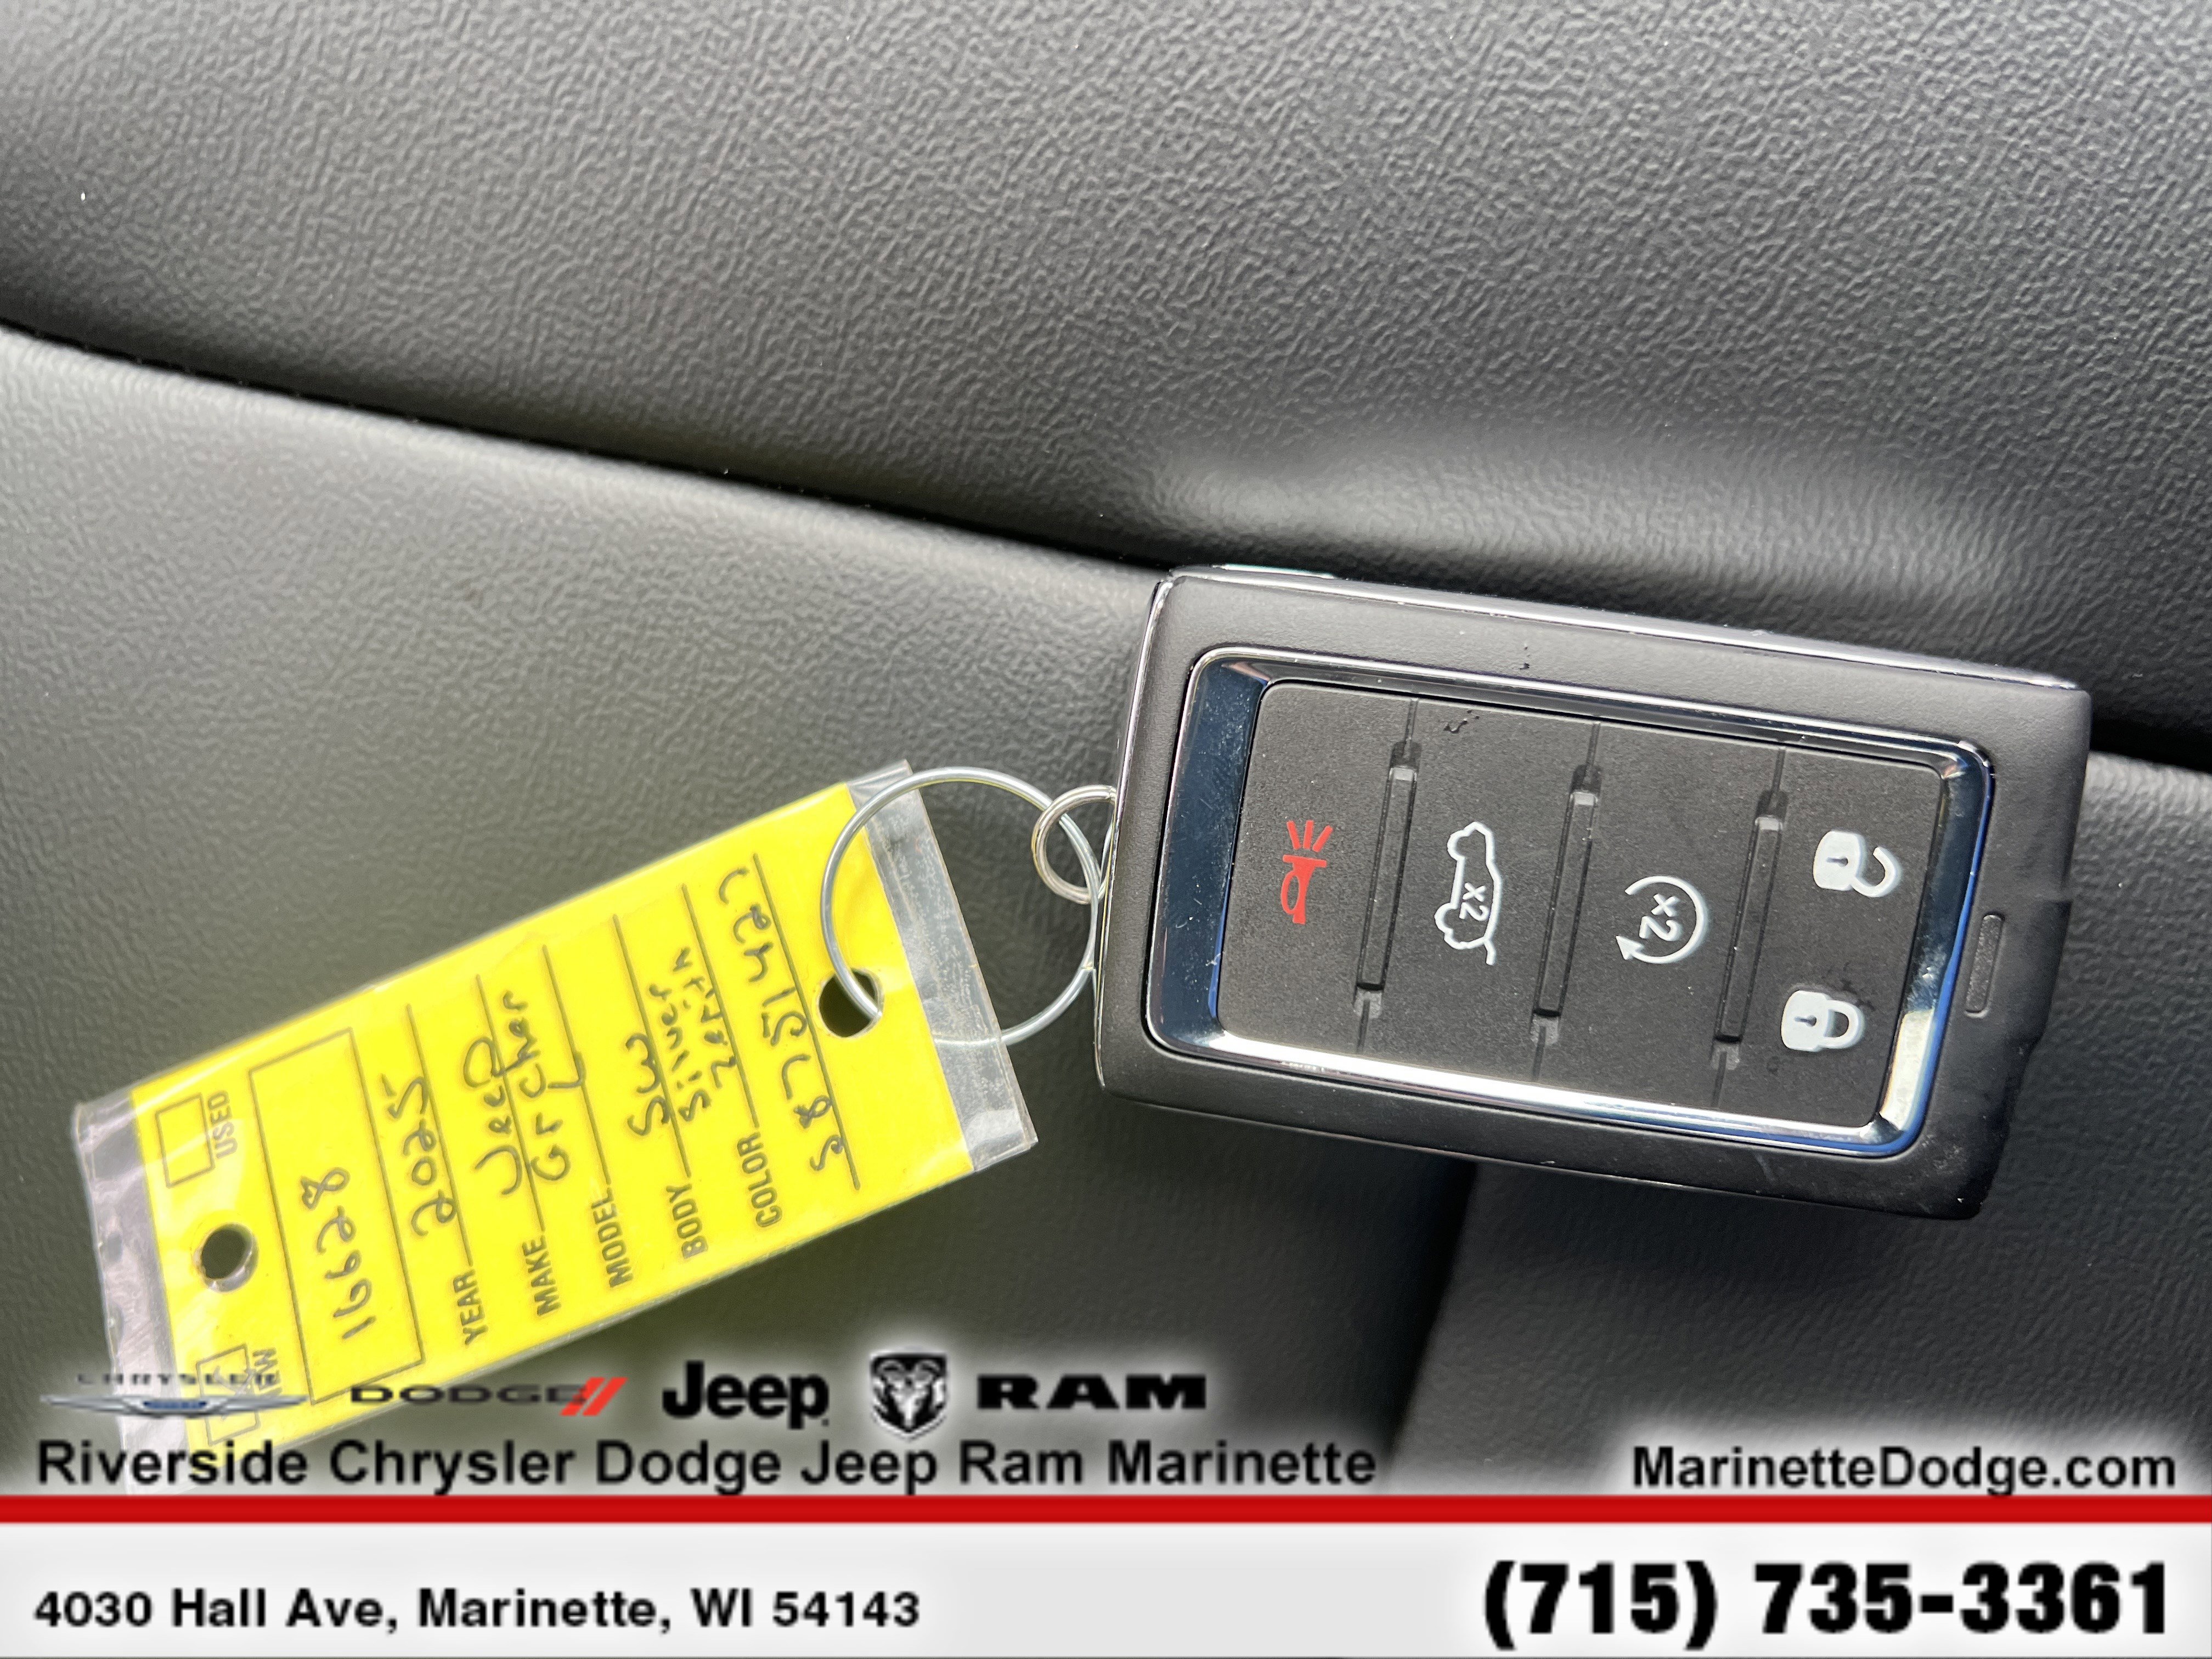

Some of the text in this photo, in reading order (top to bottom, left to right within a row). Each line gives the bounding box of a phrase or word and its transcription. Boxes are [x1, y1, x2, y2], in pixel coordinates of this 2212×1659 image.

[207, 1090, 238, 1160] USED
[381, 1074, 457, 1237] 2025
[665, 1183, 707, 1259] BODY
[737, 1132, 783, 1228] COLOR
[300, 1167, 377, 1340] 16628
[522, 1235, 562, 1317] MAKE
[591, 1188, 633, 1288] MODEL
[452, 1268, 488, 1345] YEAR
